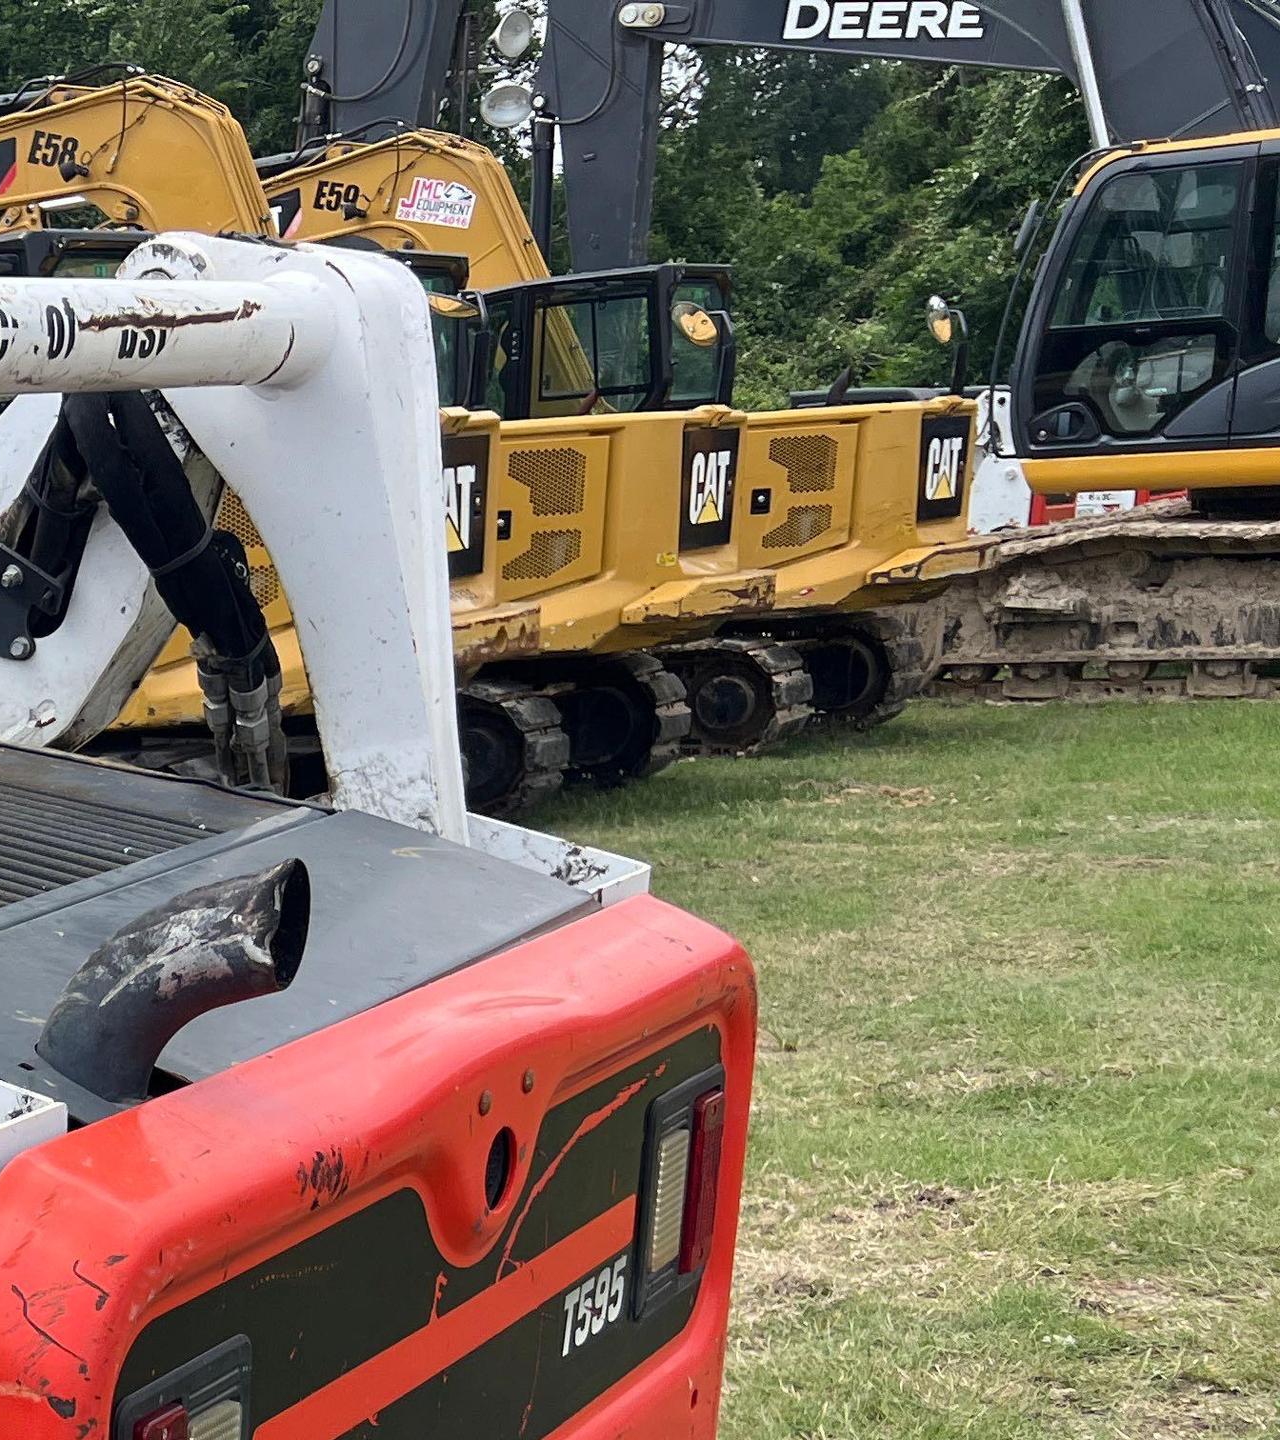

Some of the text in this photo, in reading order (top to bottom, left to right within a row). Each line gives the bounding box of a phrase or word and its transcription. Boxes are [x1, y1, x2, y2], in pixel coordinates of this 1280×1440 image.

[782, 0, 984, 39] DEERE
[28, 130, 80, 168] E58
[401, 179, 444, 208] JMC
[689, 450, 731, 525] CAT
[924, 437, 963, 499] CAT
[442, 465, 476, 551] AT
[562, 1254, 628, 1358] T595
